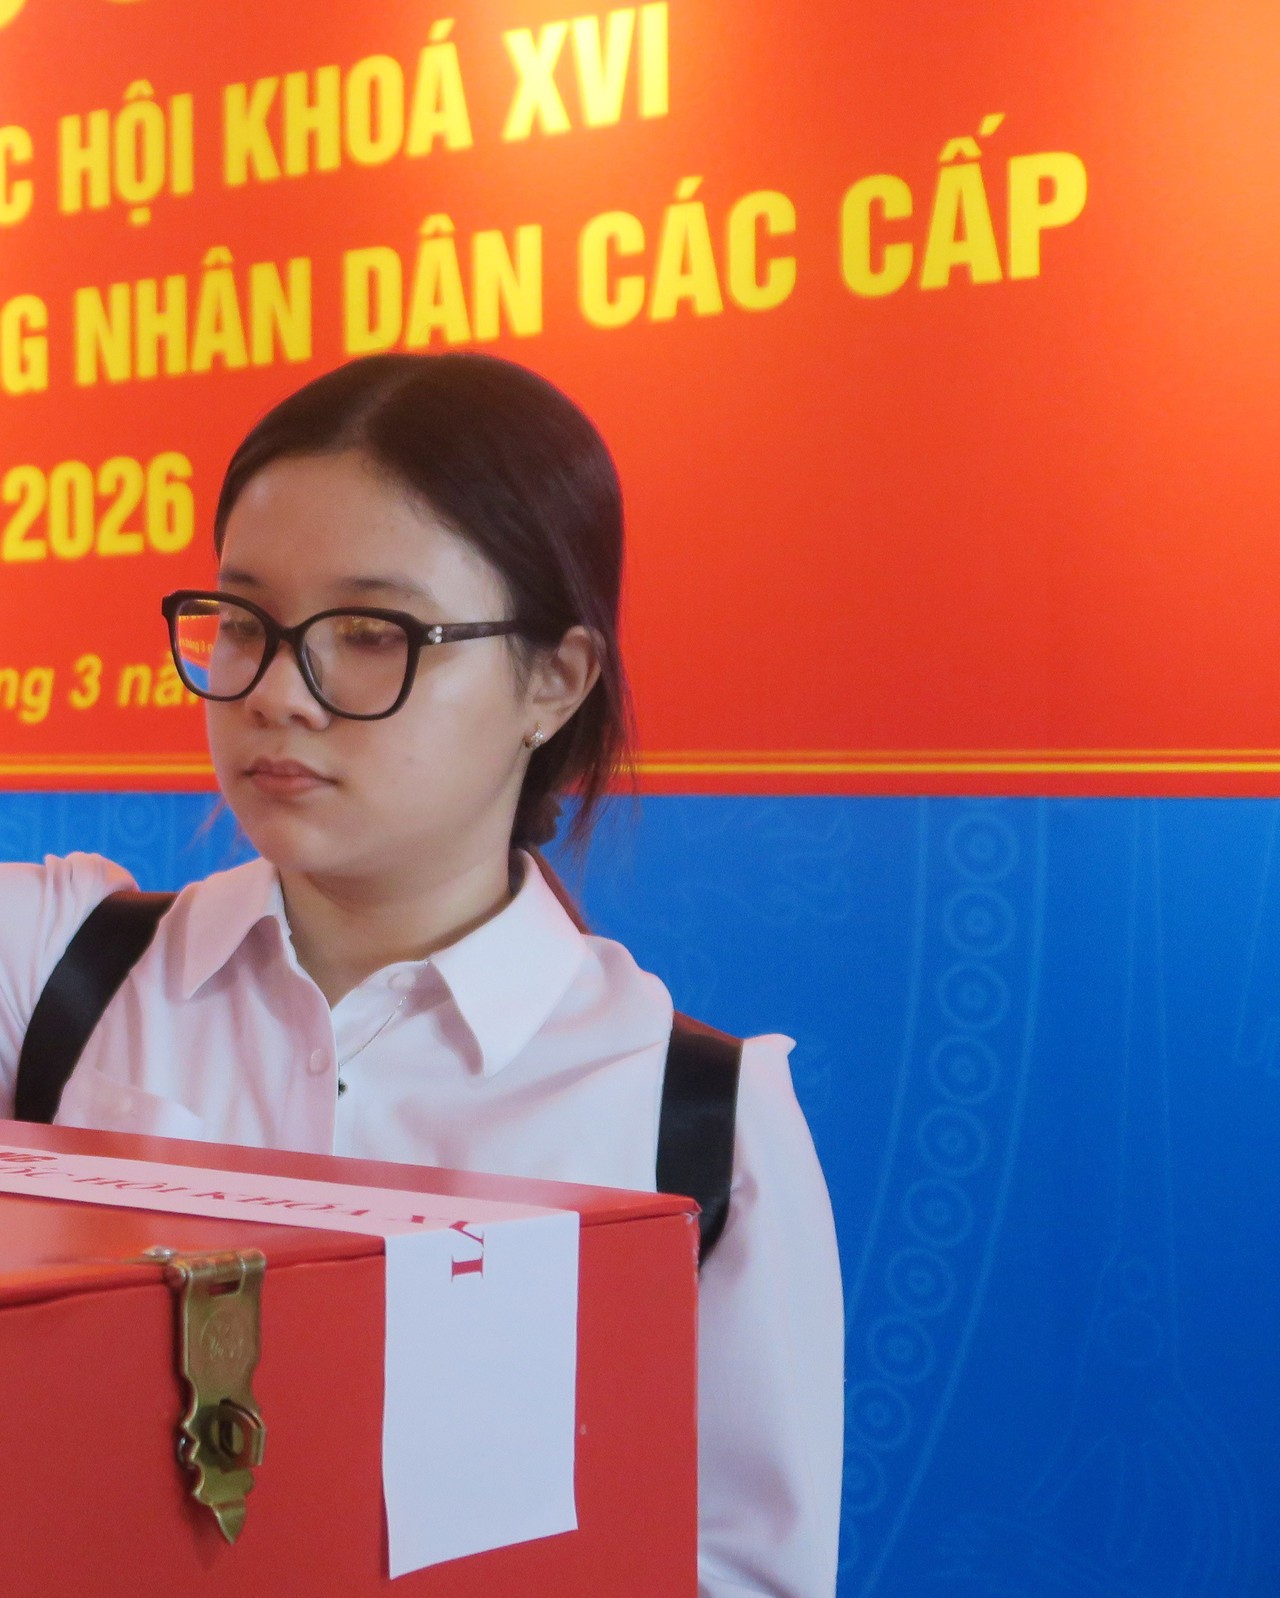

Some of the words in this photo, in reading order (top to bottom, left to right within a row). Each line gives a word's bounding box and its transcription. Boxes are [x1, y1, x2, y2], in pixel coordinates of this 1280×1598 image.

[59, 79, 193, 225] HỘI
[223, 18, 472, 187] KHOÁ
[501, 2, 669, 143] XVI
[75, 246, 312, 387] NHÂN
[343, 213, 543, 356] DÂN
[578, 175, 797, 328] CÁC
[840, 112, 1089, 298] CẤP
[70, 654, 103, 709] 3
